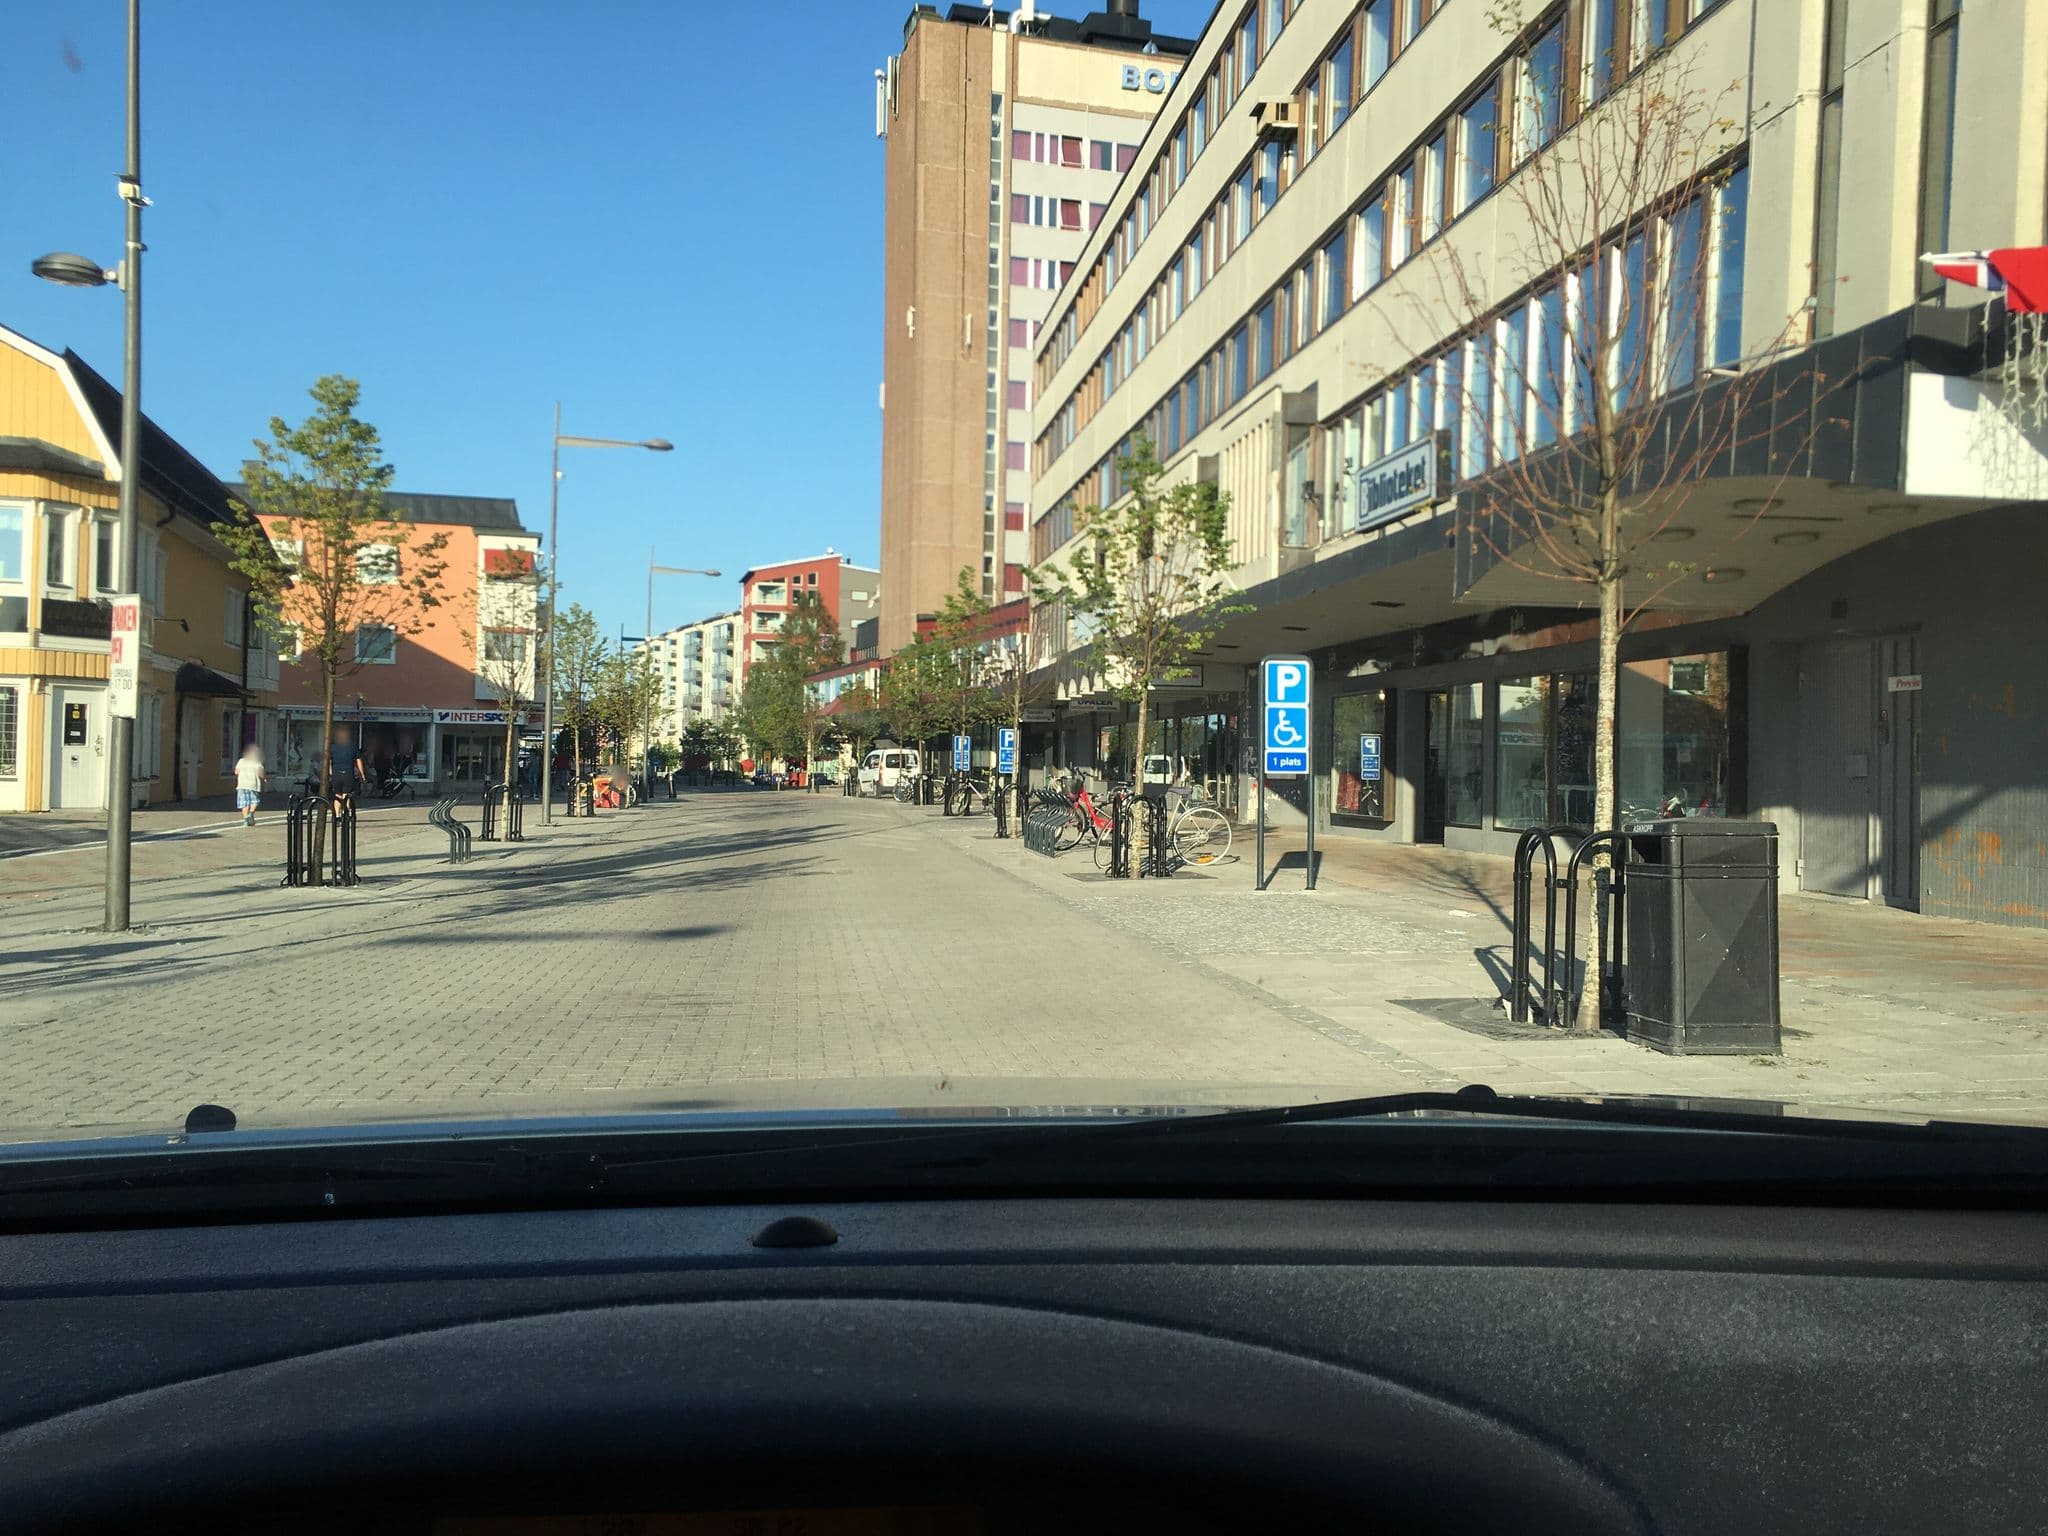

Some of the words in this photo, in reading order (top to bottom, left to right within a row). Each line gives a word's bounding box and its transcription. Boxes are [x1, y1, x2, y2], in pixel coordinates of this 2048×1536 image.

[1277, 665, 1302, 701] P
[451, 711, 519, 723] INTERSPO
[1273, 757, 1278, 766] 1
[1280, 757, 1302, 768] plats
